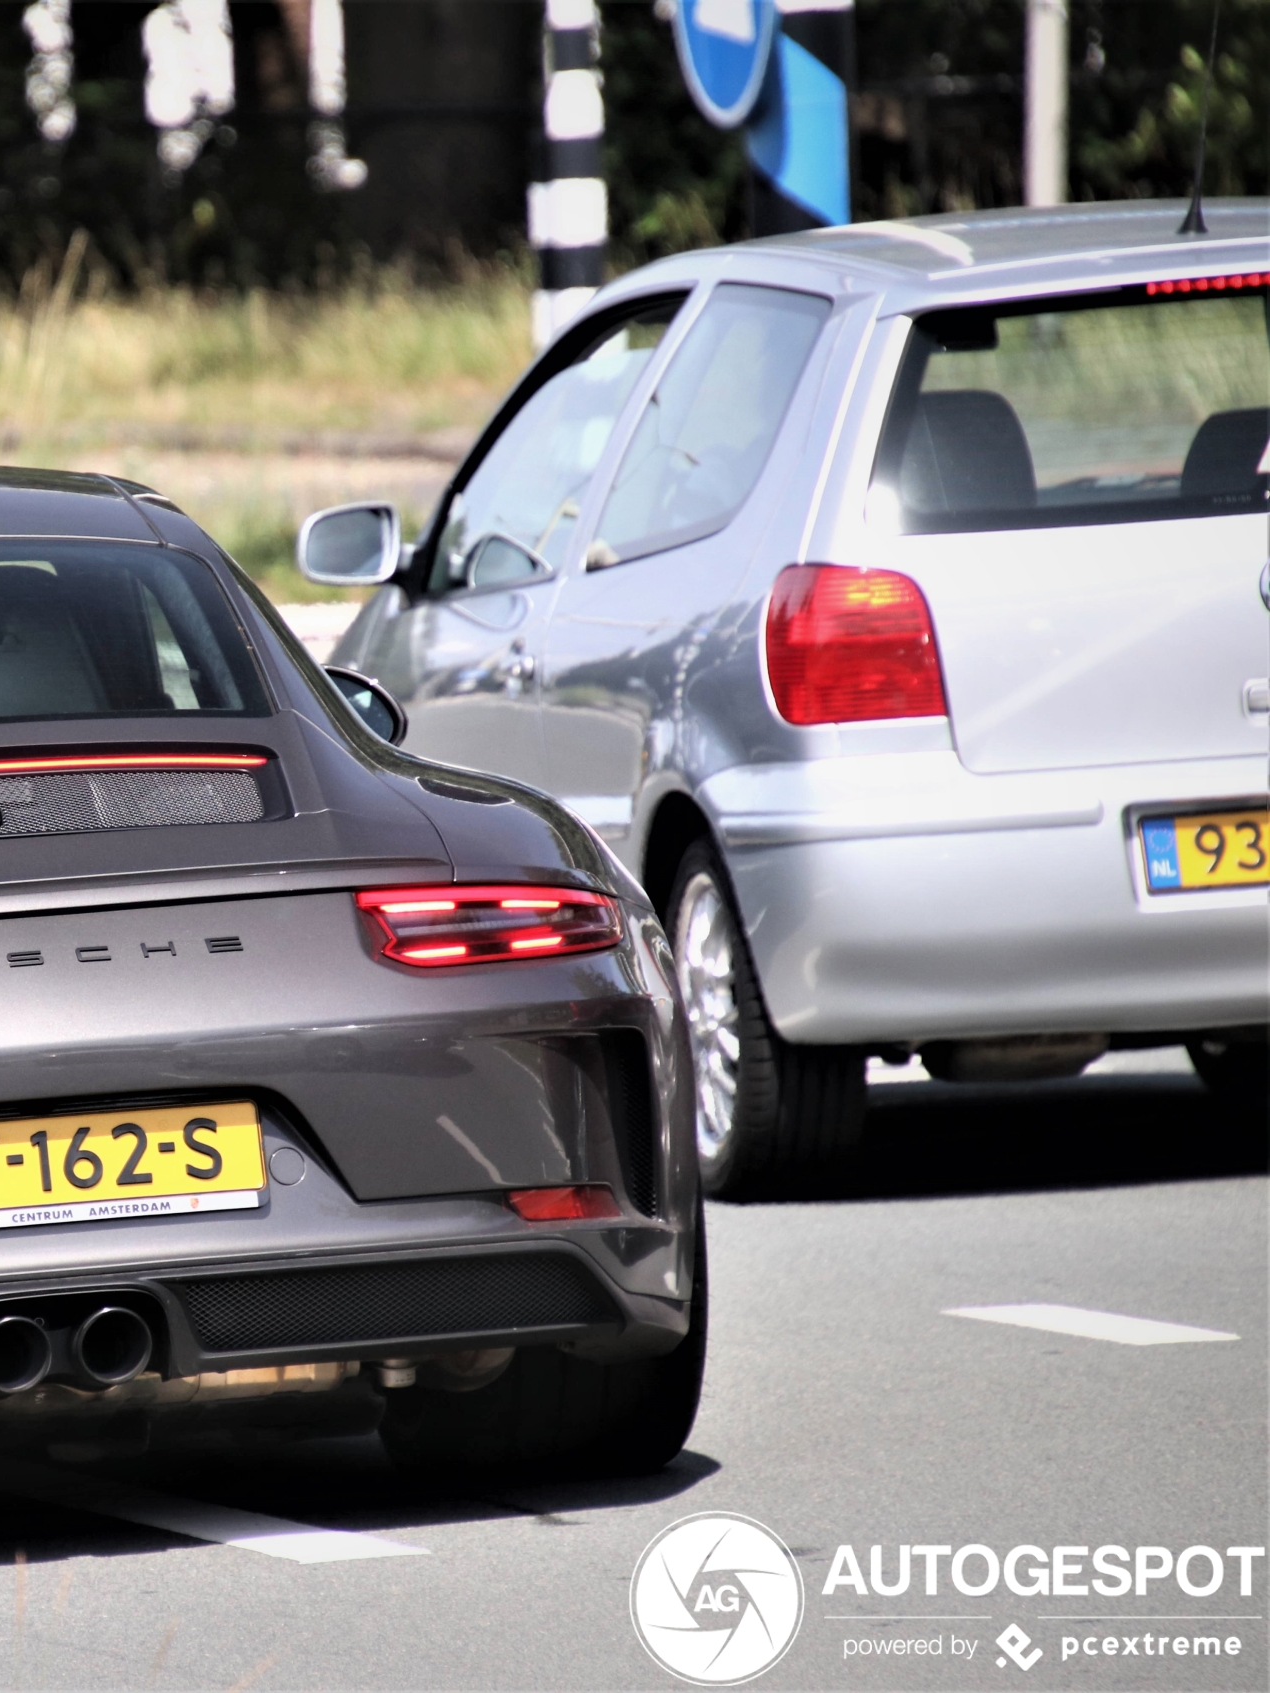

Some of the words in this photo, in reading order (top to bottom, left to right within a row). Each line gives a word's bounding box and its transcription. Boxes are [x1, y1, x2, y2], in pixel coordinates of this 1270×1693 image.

[1195, 820, 1267, 874] 93
[1151, 859, 1177, 878] NL
[11, 1209, 74, 1223] CENTRUM
[88, 1201, 172, 1217] AMSTERDAM
